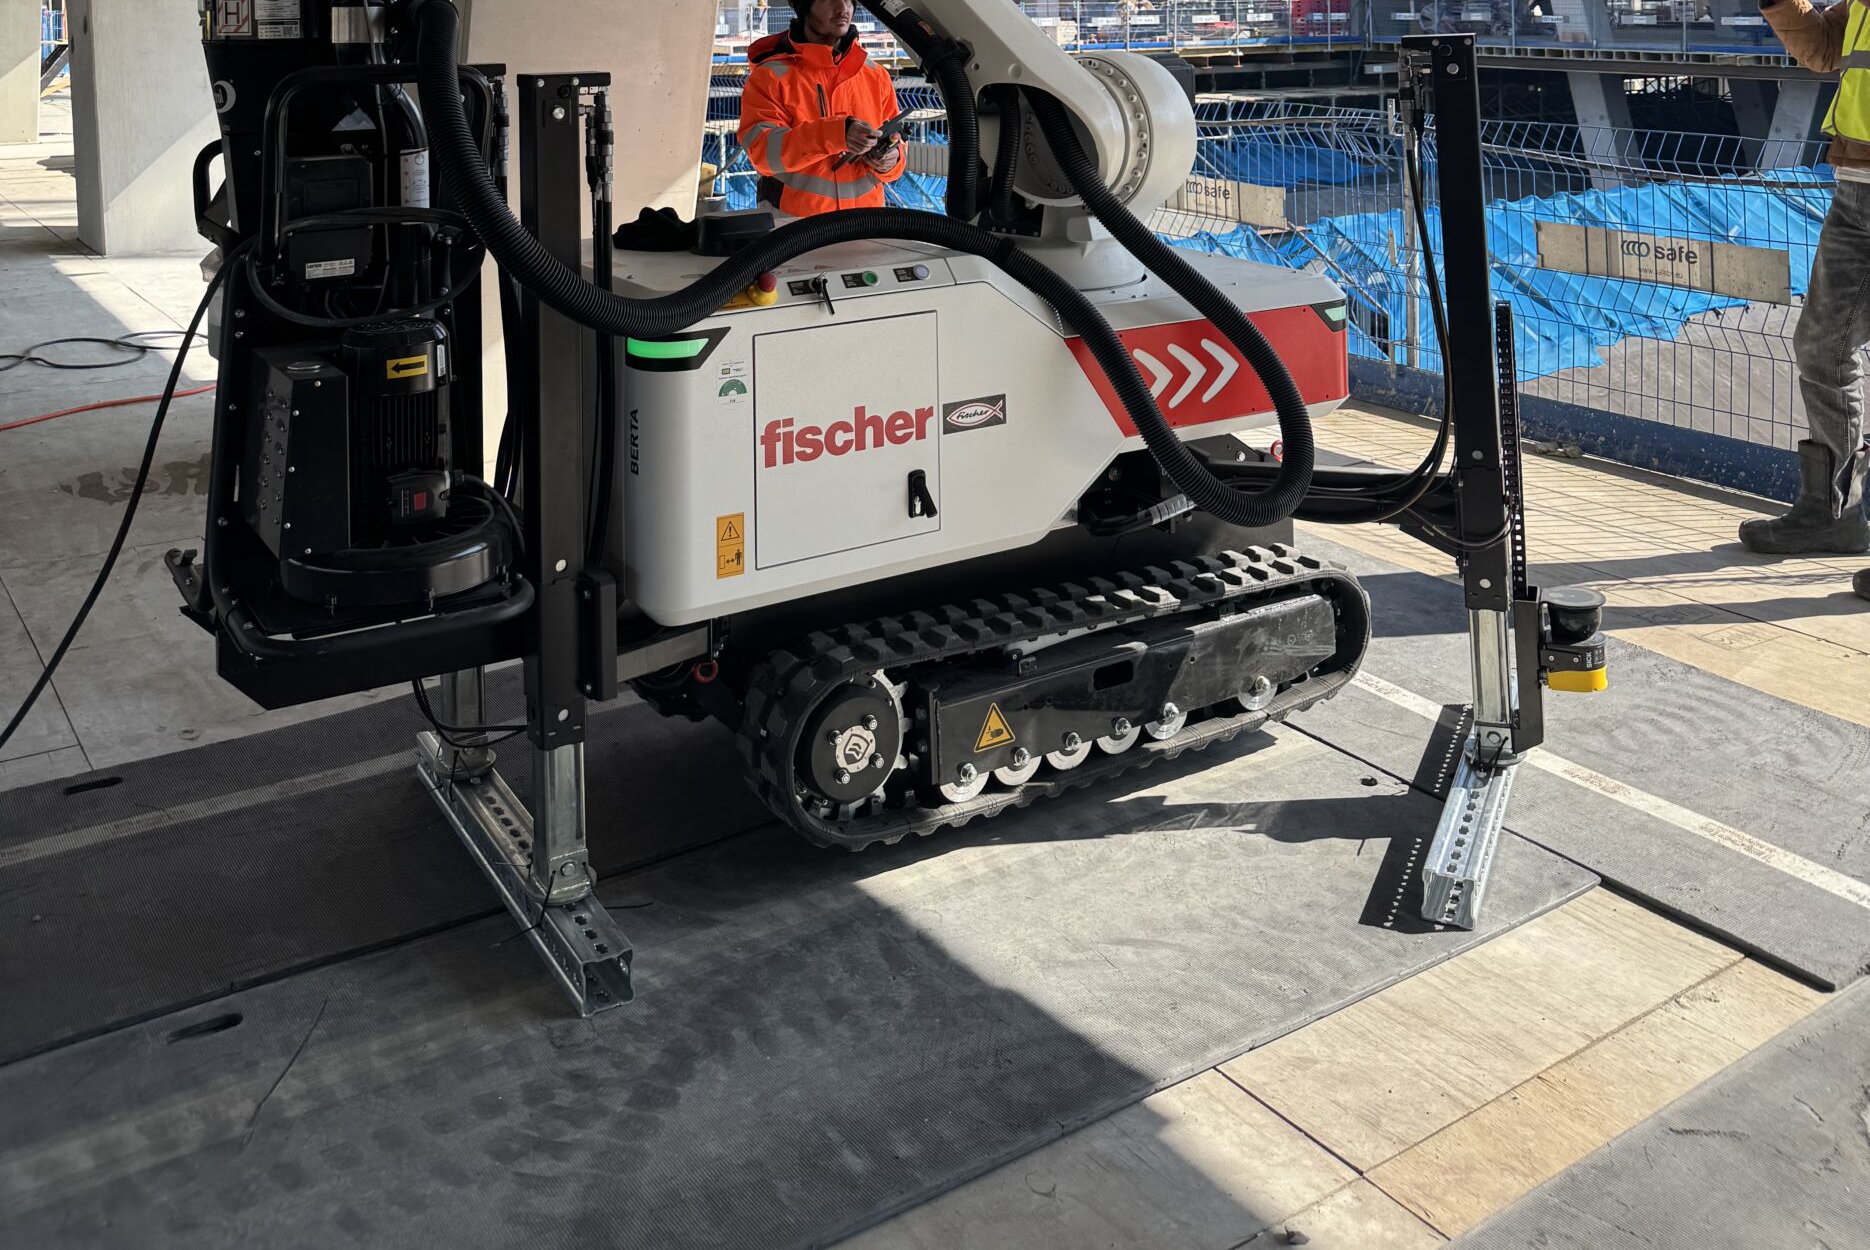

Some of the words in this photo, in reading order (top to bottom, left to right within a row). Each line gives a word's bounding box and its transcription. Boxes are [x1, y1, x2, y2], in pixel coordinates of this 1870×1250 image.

[224, 1, 240, 25] H
[1655, 246, 1698, 265] safe
[629, 408, 640, 476] BERTA
[760, 405, 935, 469] fischer
